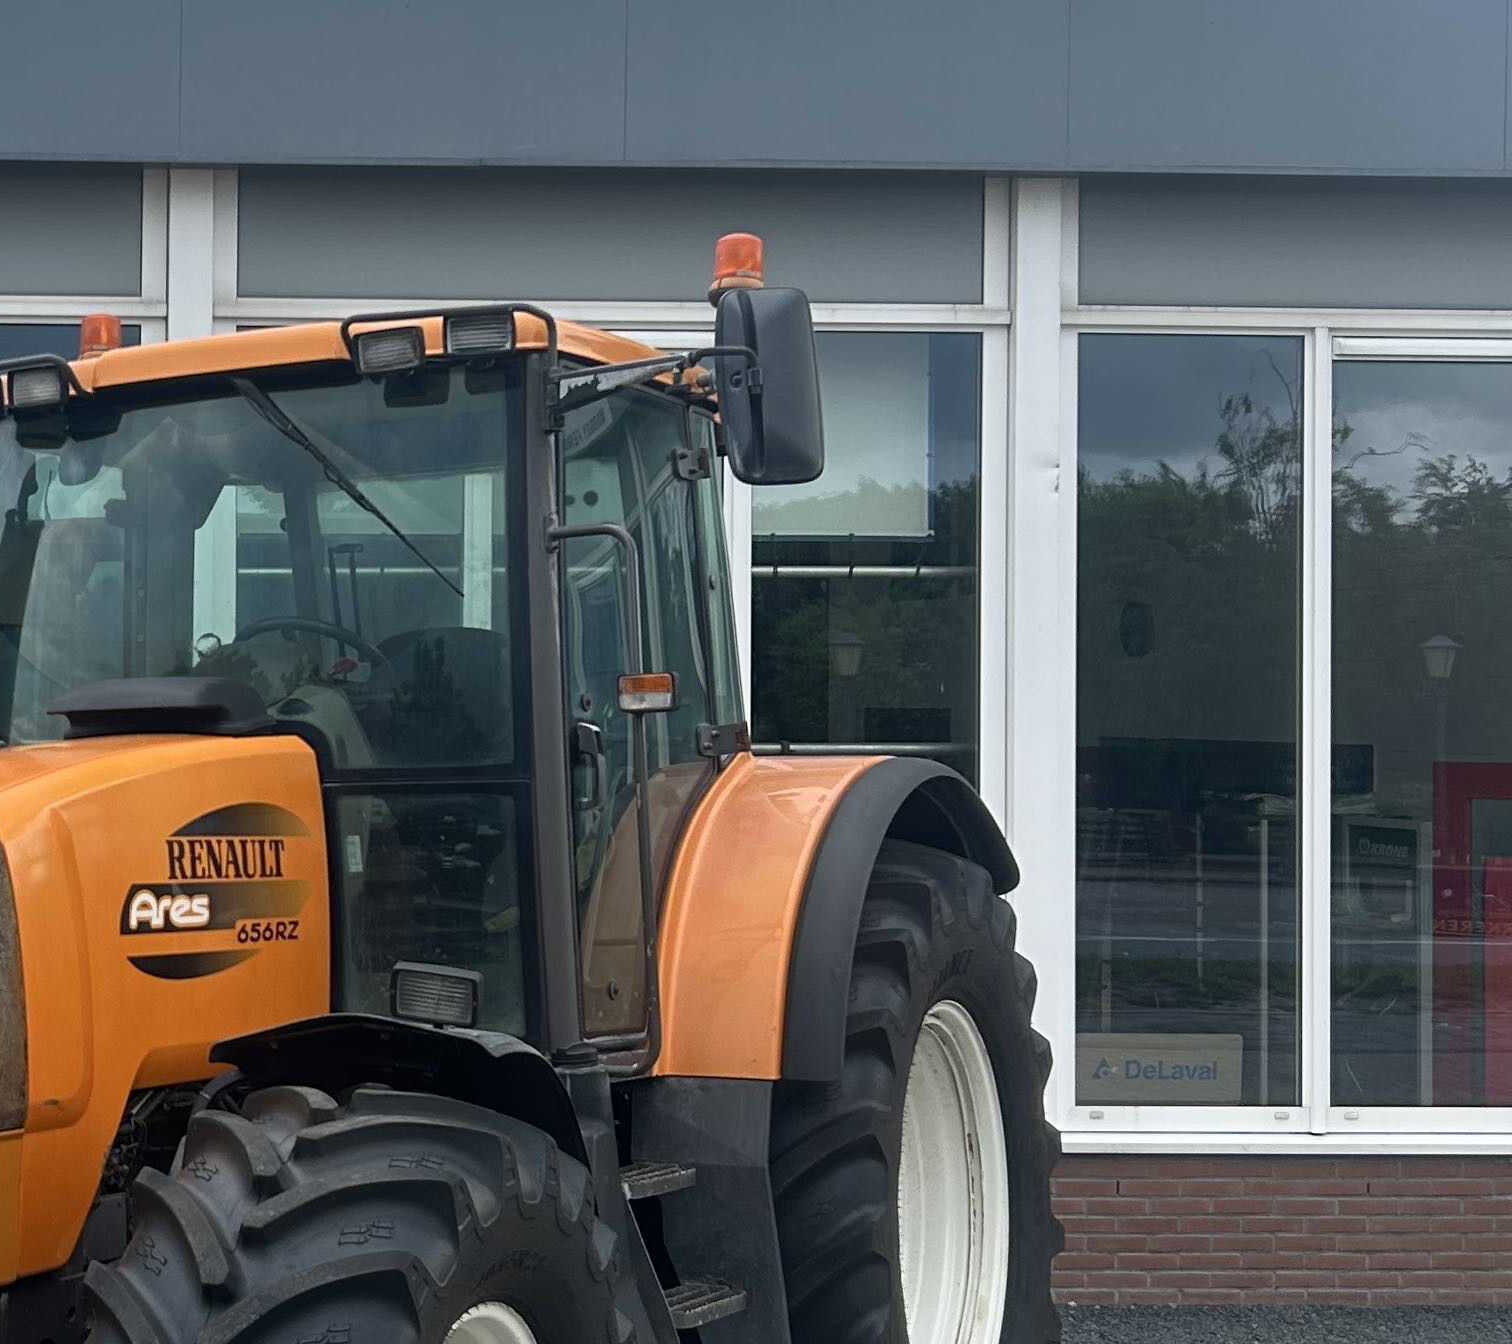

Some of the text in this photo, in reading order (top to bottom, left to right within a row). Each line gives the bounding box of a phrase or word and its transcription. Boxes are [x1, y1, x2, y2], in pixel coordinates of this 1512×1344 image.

[165, 839, 285, 881] RENAULT
[128, 889, 210, 931] Ares
[237, 921, 299, 944] 656RZ
[1125, 1059, 1218, 1080] DeLaval
